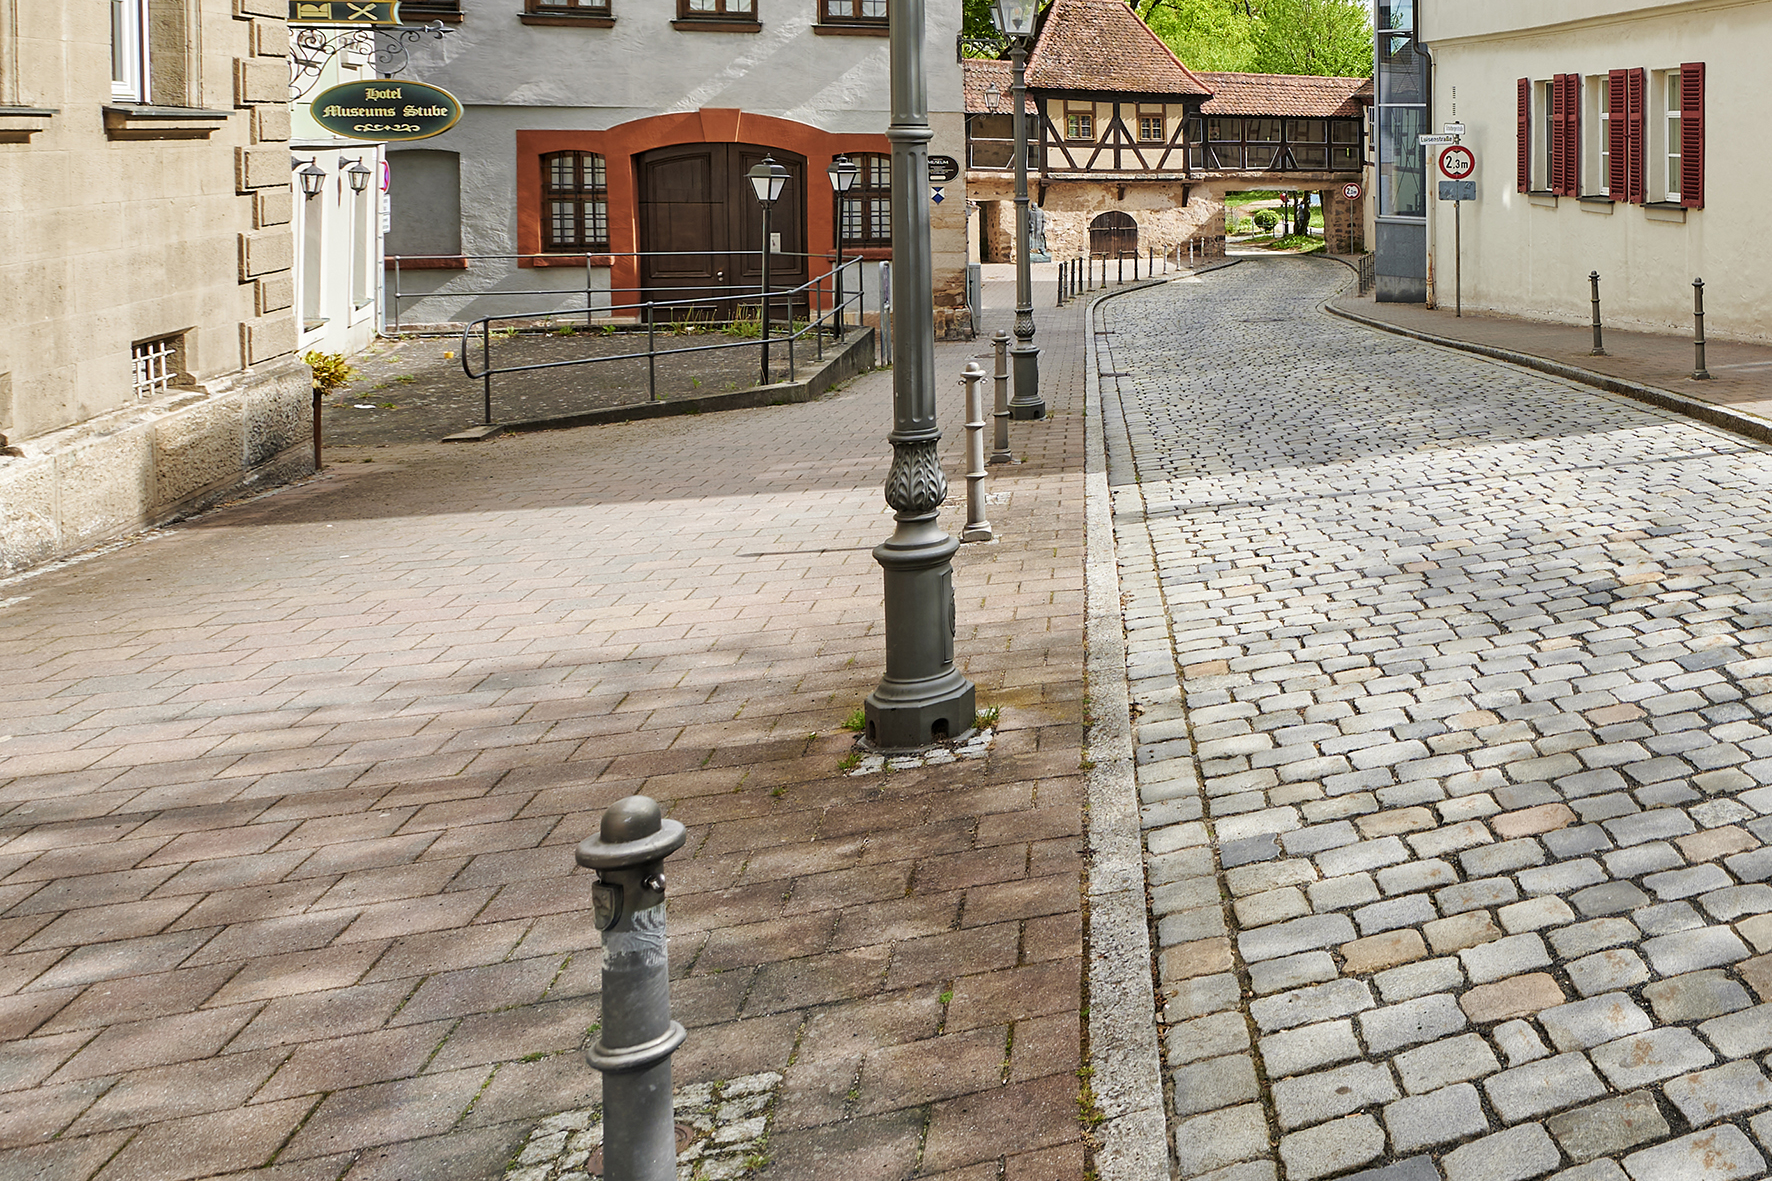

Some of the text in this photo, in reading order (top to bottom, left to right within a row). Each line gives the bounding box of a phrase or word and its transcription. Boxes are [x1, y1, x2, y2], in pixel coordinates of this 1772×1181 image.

[365, 87, 403, 101] Hotel
[322, 104, 449, 117] Museums Stube
